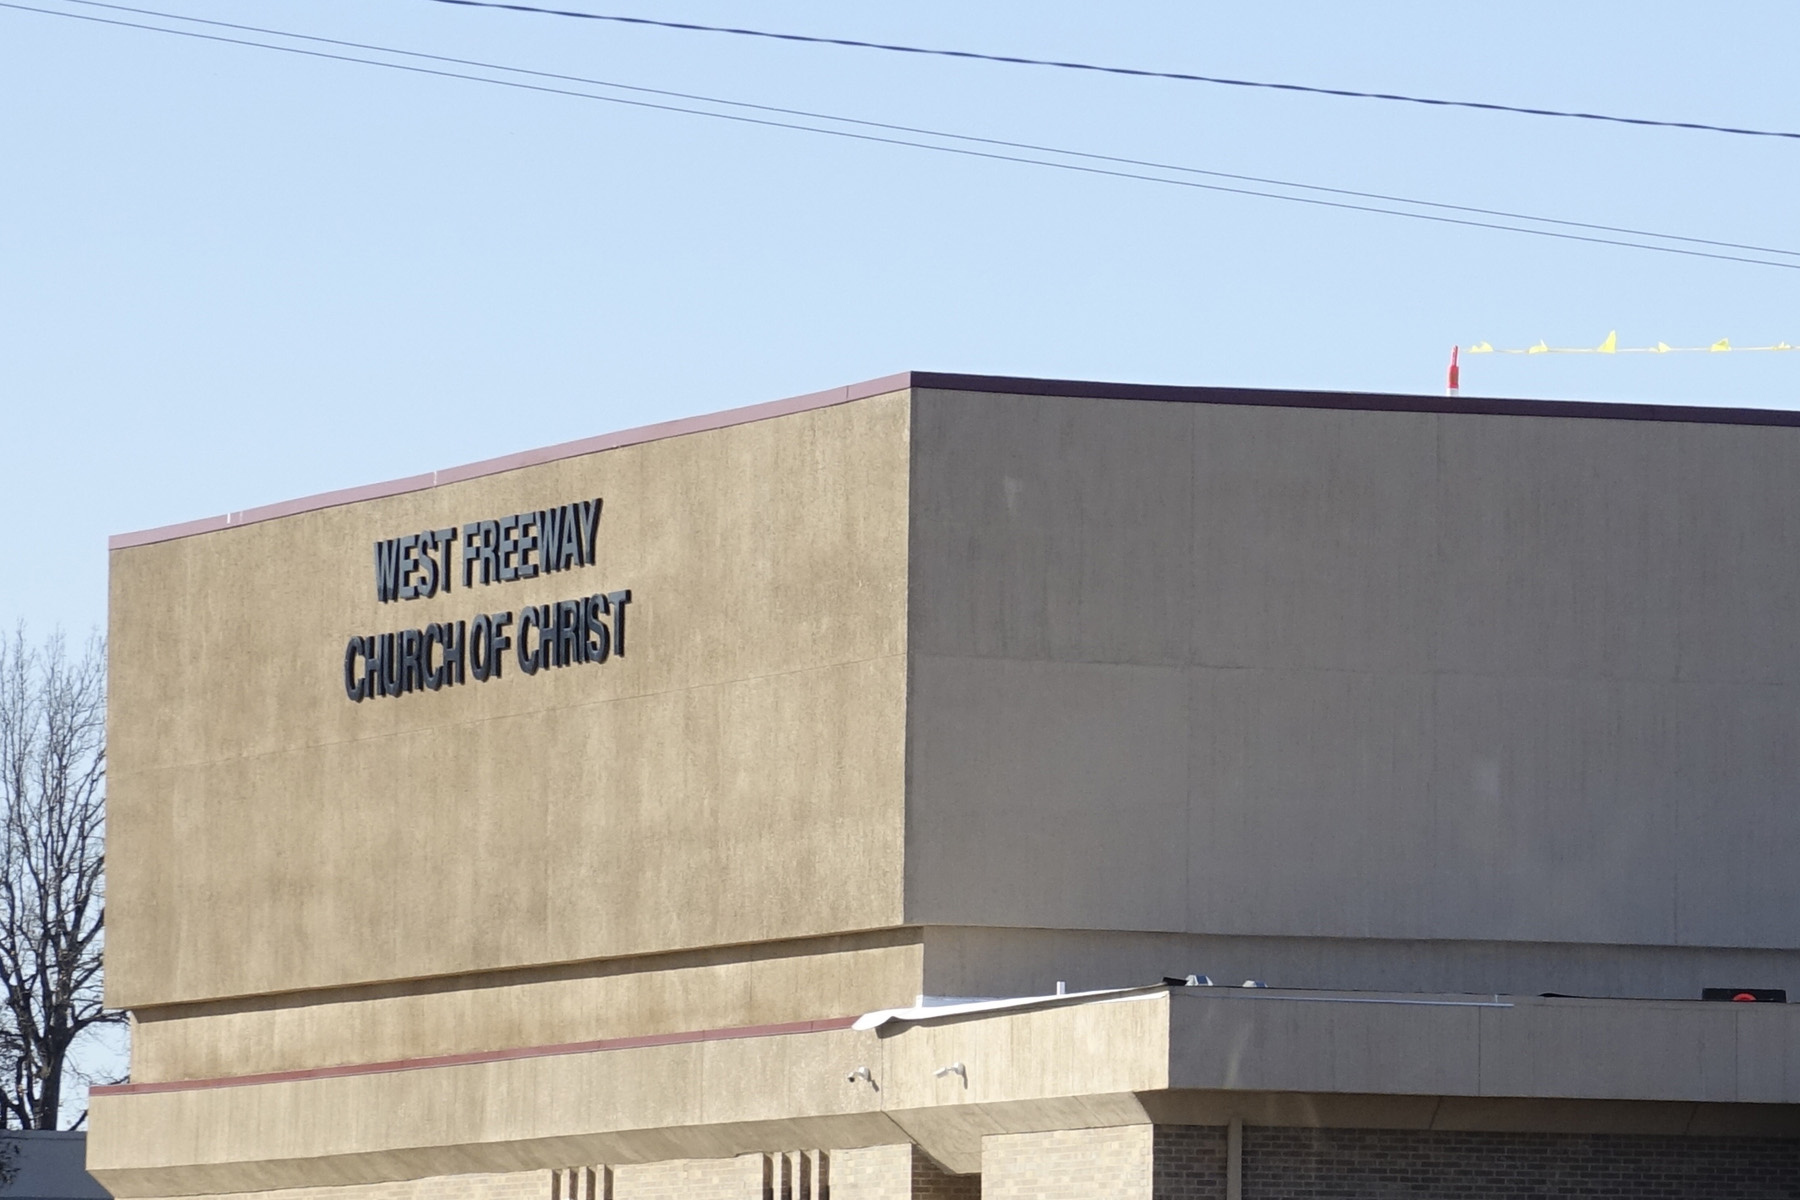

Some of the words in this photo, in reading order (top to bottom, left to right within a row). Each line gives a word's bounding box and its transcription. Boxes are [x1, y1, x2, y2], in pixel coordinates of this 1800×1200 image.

[374, 527, 458, 604] WEST
[462, 497, 603, 588] FREEWAY
[344, 620, 466, 703] CHURCH
[469, 611, 513, 682] OF
[517, 589, 633, 676] CHRIST
